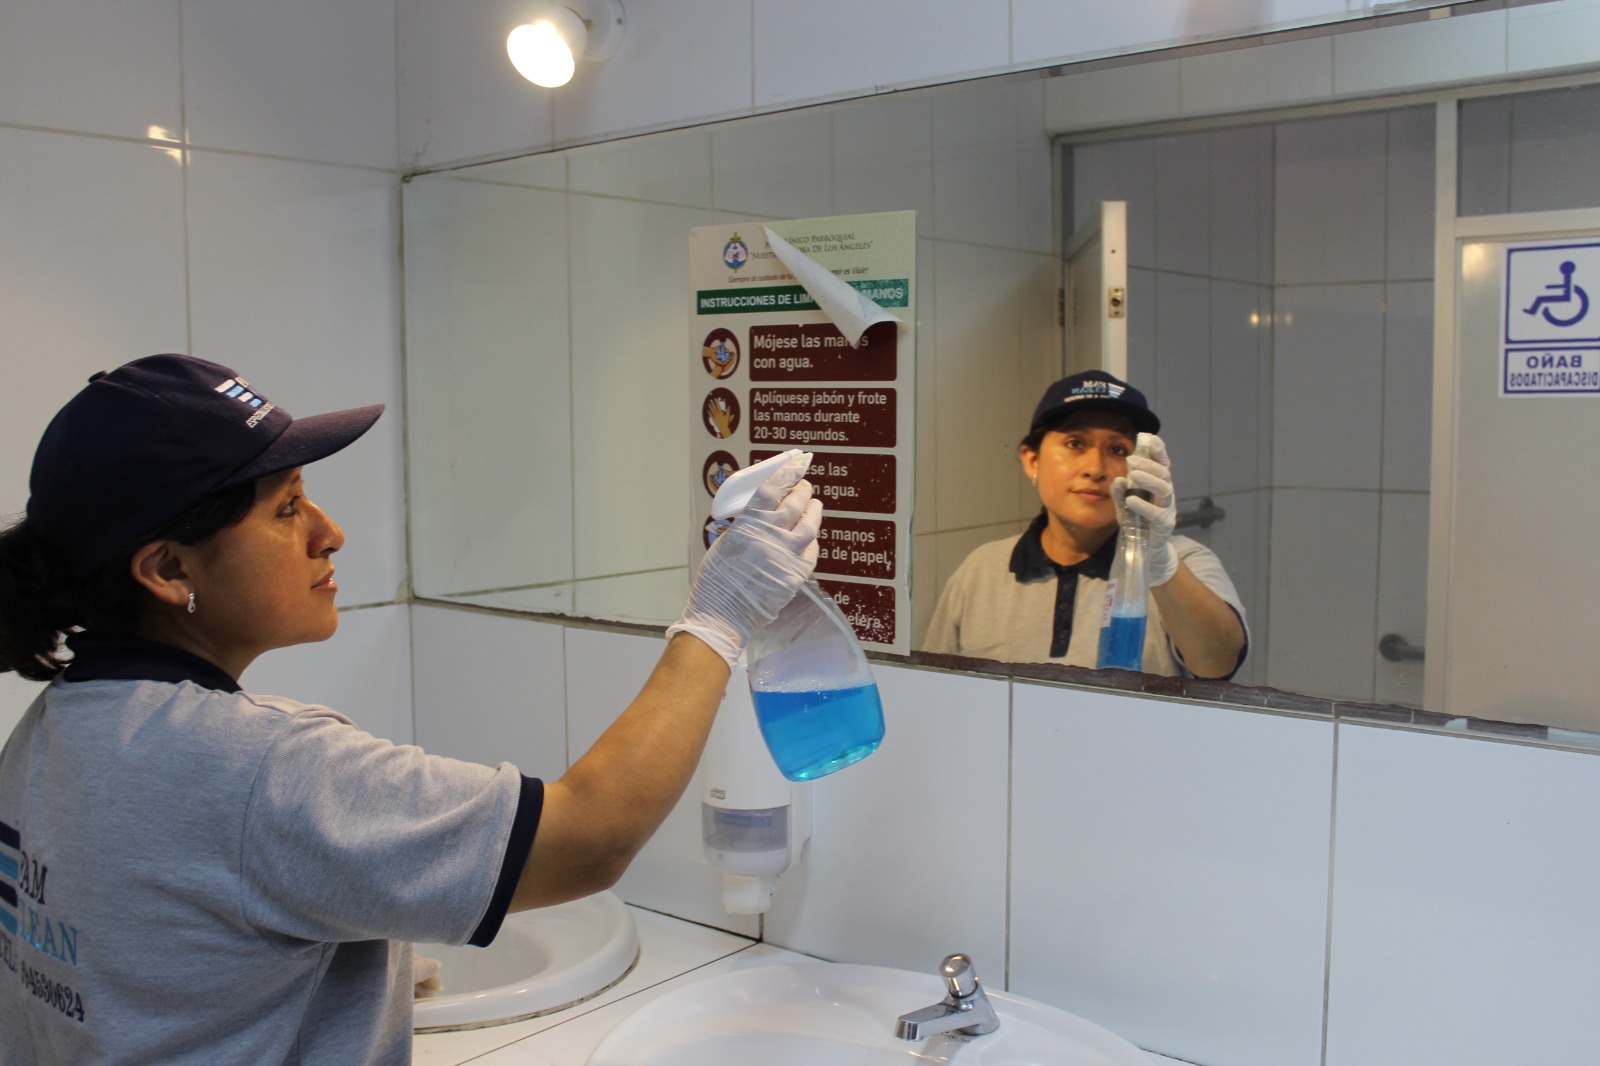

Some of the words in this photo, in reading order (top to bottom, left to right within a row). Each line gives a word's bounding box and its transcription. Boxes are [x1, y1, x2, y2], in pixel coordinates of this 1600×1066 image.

[812, 245, 823, 253] DE
[824, 243, 838, 252] LOS
[700, 295, 776, 308] INSTRUCCIONES
[778, 294, 791, 305] DE
[754, 334, 798, 351] Mójese
[801, 334, 820, 348] las
[824, 335, 869, 348] mas
[754, 358, 776, 369] con
[779, 358, 813, 371] agua.
[754, 391, 810, 406] Aplíquese
[812, 391, 845, 407] jabón
[848, 393, 855, 407] y
[858, 392, 887, 404] frote
[754, 409, 771, 421] las
[773, 411, 811, 422] manos
[814, 411, 860, 423] durante
[754, 427, 787, 439] 20-30
[789, 428, 849, 443] segundos.
[829, 462, 848, 476] las
[823, 485, 859, 500] agua.
[831, 529, 875, 543] manos
[832, 547, 848, 560] de
[834, 591, 850, 605] de
